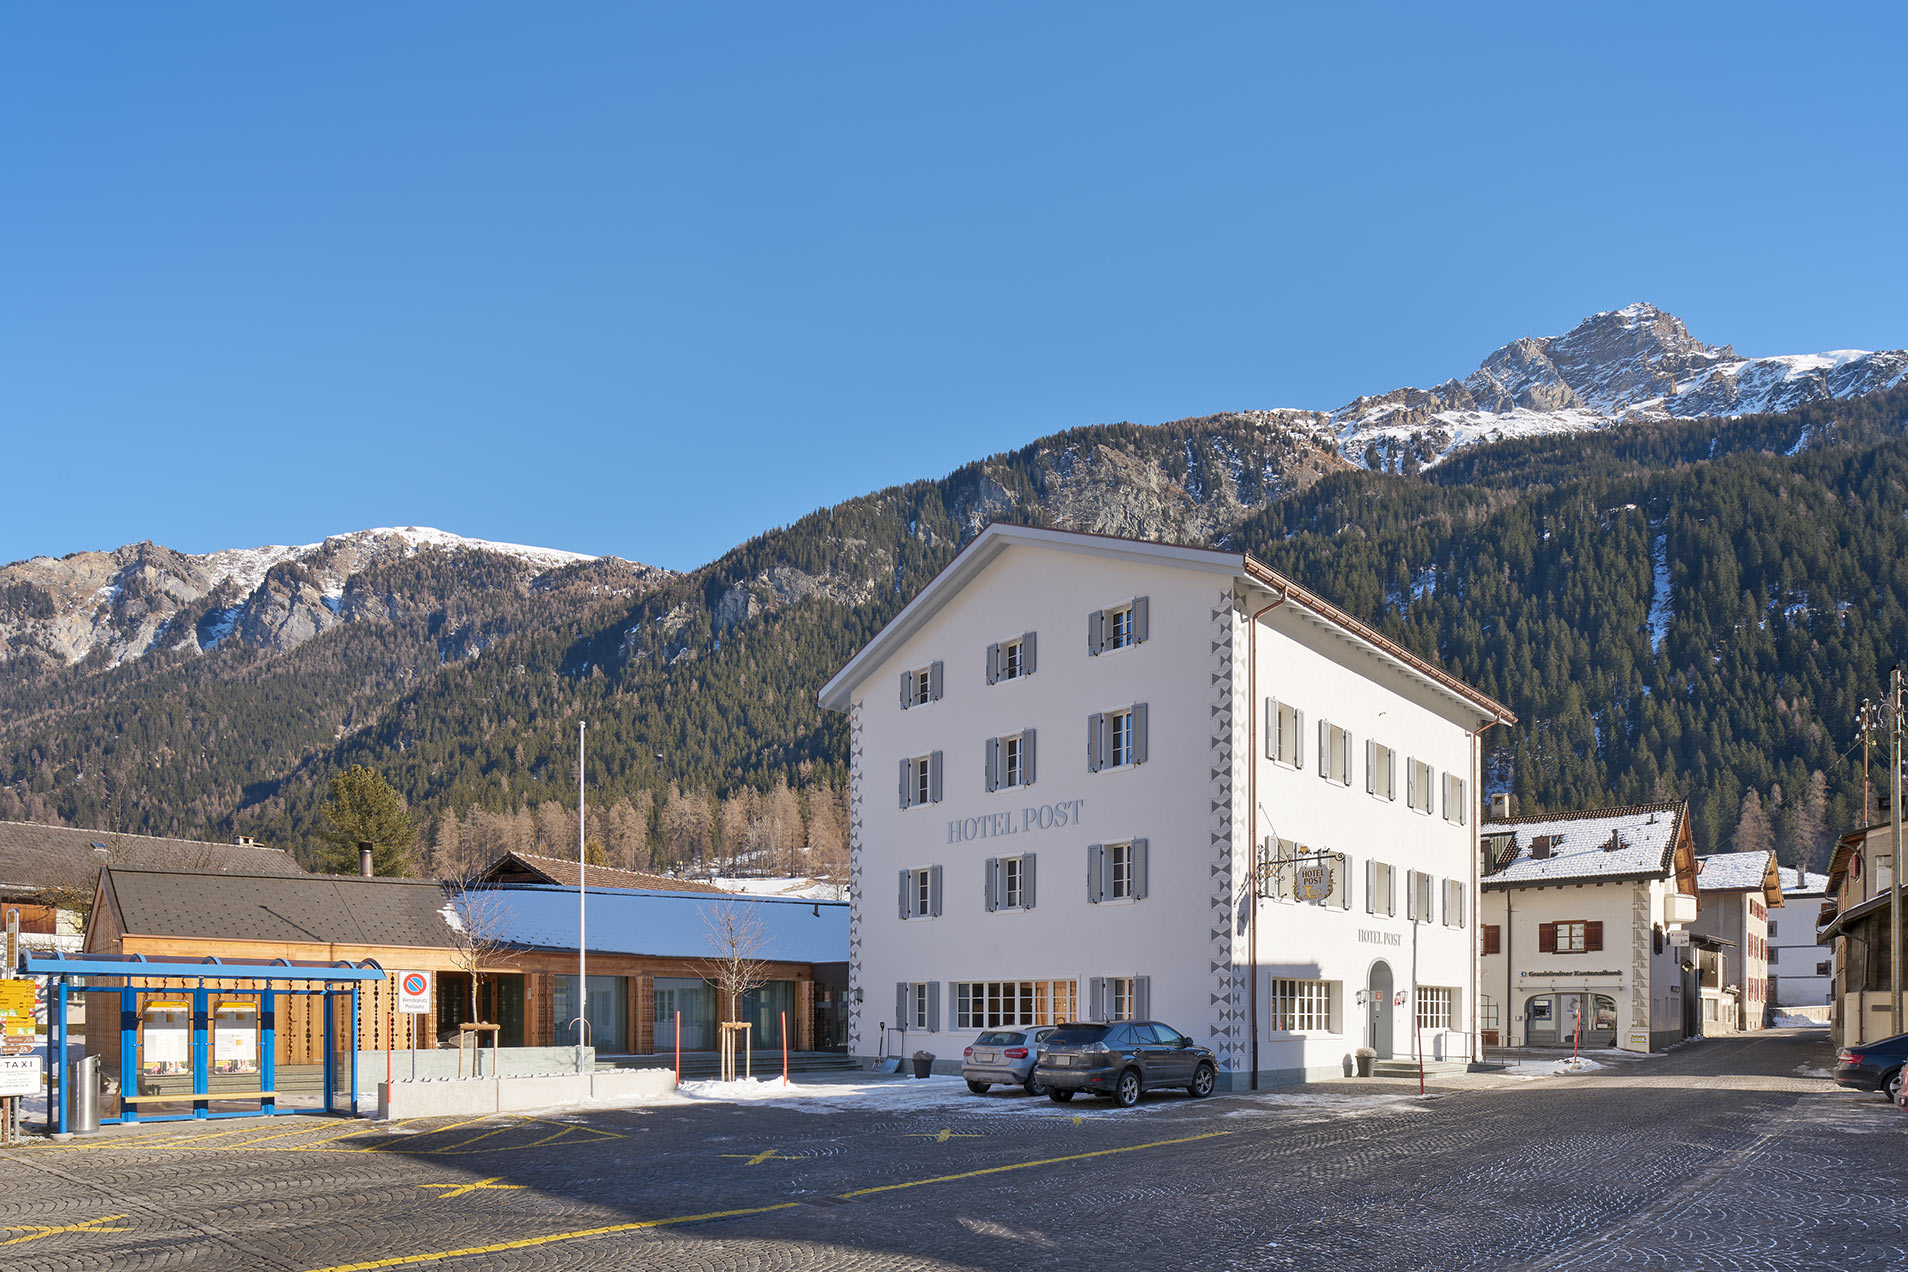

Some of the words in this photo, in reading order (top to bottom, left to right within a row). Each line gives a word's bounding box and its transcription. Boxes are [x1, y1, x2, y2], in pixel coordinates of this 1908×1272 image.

[947, 811, 1018, 844] HOTEL
[1022, 799, 1084, 832] POST
[1302, 869, 1325, 878] HOTEL
[1303, 877, 1323, 885] POST
[1358, 929, 1383, 944] HOTEL
[1383, 932, 1402, 947] POST
